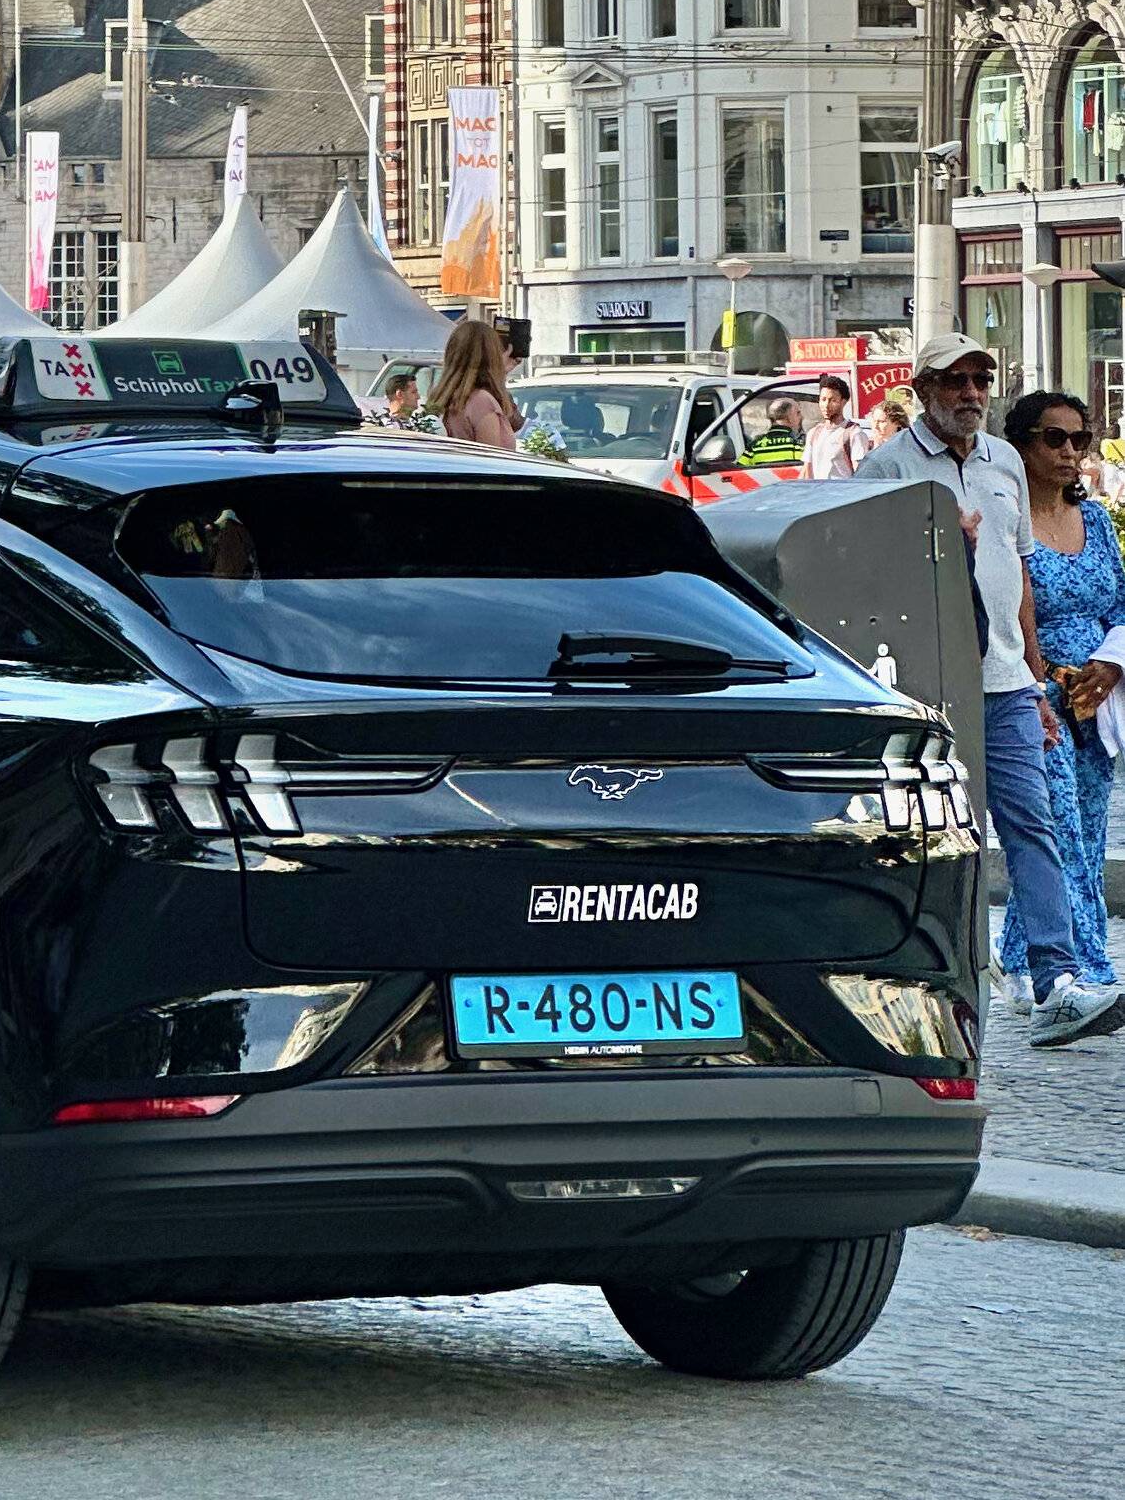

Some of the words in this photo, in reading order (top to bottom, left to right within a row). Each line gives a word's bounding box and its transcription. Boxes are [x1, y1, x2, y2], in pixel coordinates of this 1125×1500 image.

[596, 301, 645, 318] SWAROVSKI
[805, 342, 844, 360] HOTDOGS
[39, 357, 96, 380] TAXI
[249, 357, 316, 385] 049
[861, 367, 913, 396] HOTD
[562, 883, 699, 922] RENTACAB
[482, 981, 716, 1034] R-480-NS
[590, 1044, 643, 1055] AUTOMOTIVE
